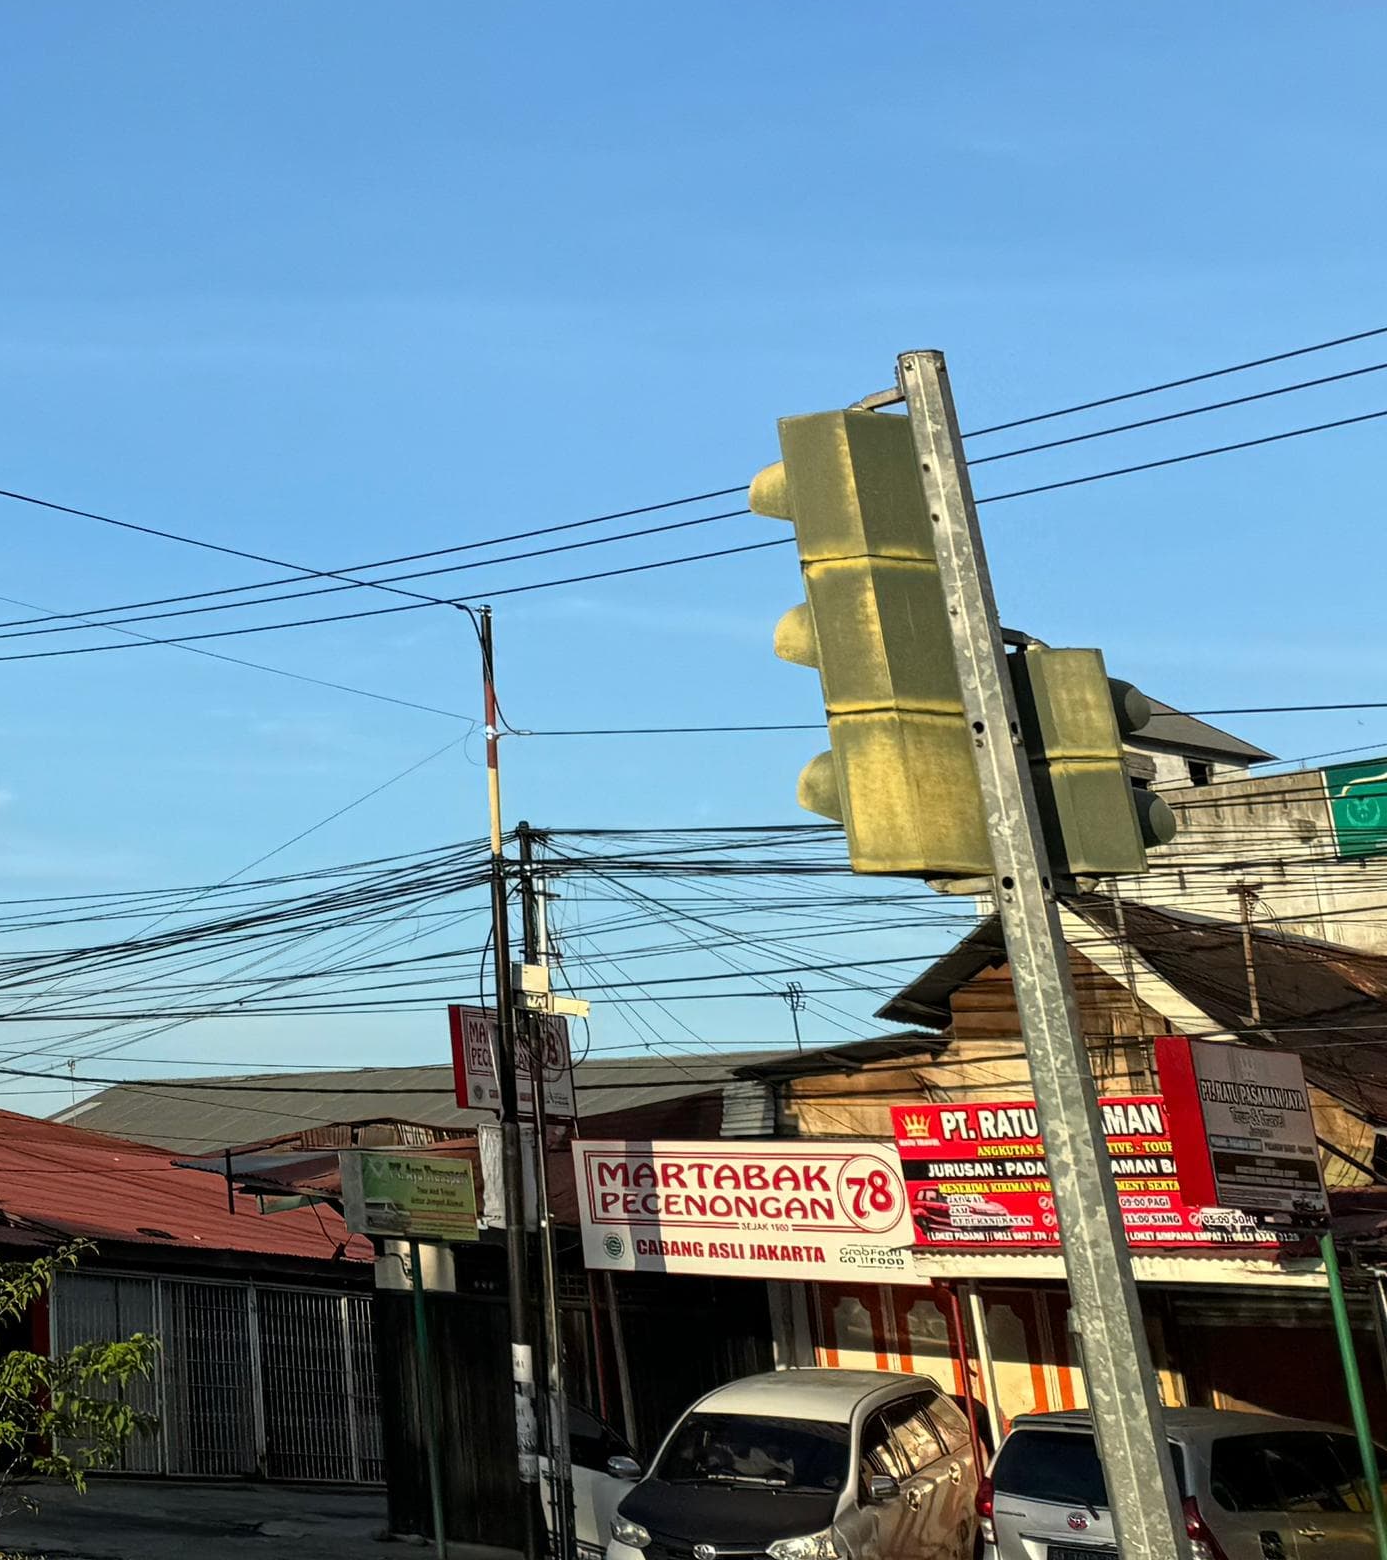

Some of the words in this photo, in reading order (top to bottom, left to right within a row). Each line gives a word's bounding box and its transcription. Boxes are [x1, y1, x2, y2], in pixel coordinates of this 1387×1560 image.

[939, 1110, 976, 1140] PT.
[978, 1108, 1040, 1139] RATU
[977, 1145, 1031, 1157] ANGKUTAN
[597, 1162, 832, 1191] MARTABAK
[928, 1163, 995, 1178] JURUSAN
[1005, 1162, 1047, 1176] PADA
[600, 1192, 835, 1220] PECENONGAN
[845, 1170, 895, 1219] 78
[1148, 1198, 1169, 1207] PAGI
[1151, 1215, 1180, 1223] SIANG
[636, 1239, 705, 1259] CABANG
[708, 1243, 745, 1261] ASLI
[749, 1244, 826, 1263] JAKARTA
